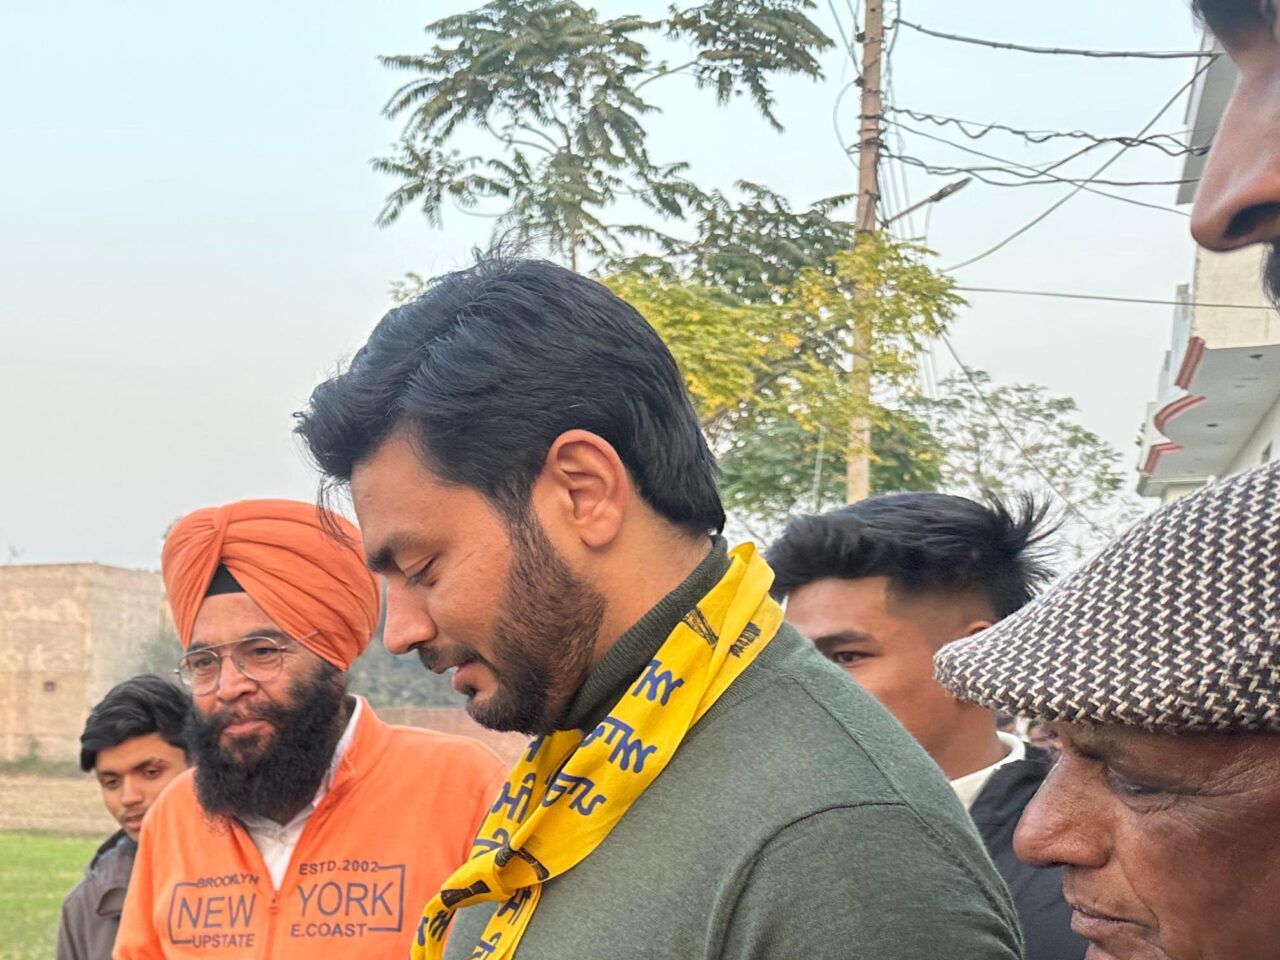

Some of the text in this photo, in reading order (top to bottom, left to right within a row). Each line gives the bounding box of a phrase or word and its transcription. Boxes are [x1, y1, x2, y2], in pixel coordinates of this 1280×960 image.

[196, 872, 259, 889] BROOKLYN
[177, 880, 395, 930] NEW YORK
[290, 922, 368, 938] E.COAST
[191, 933, 255, 949] UPSTATE
